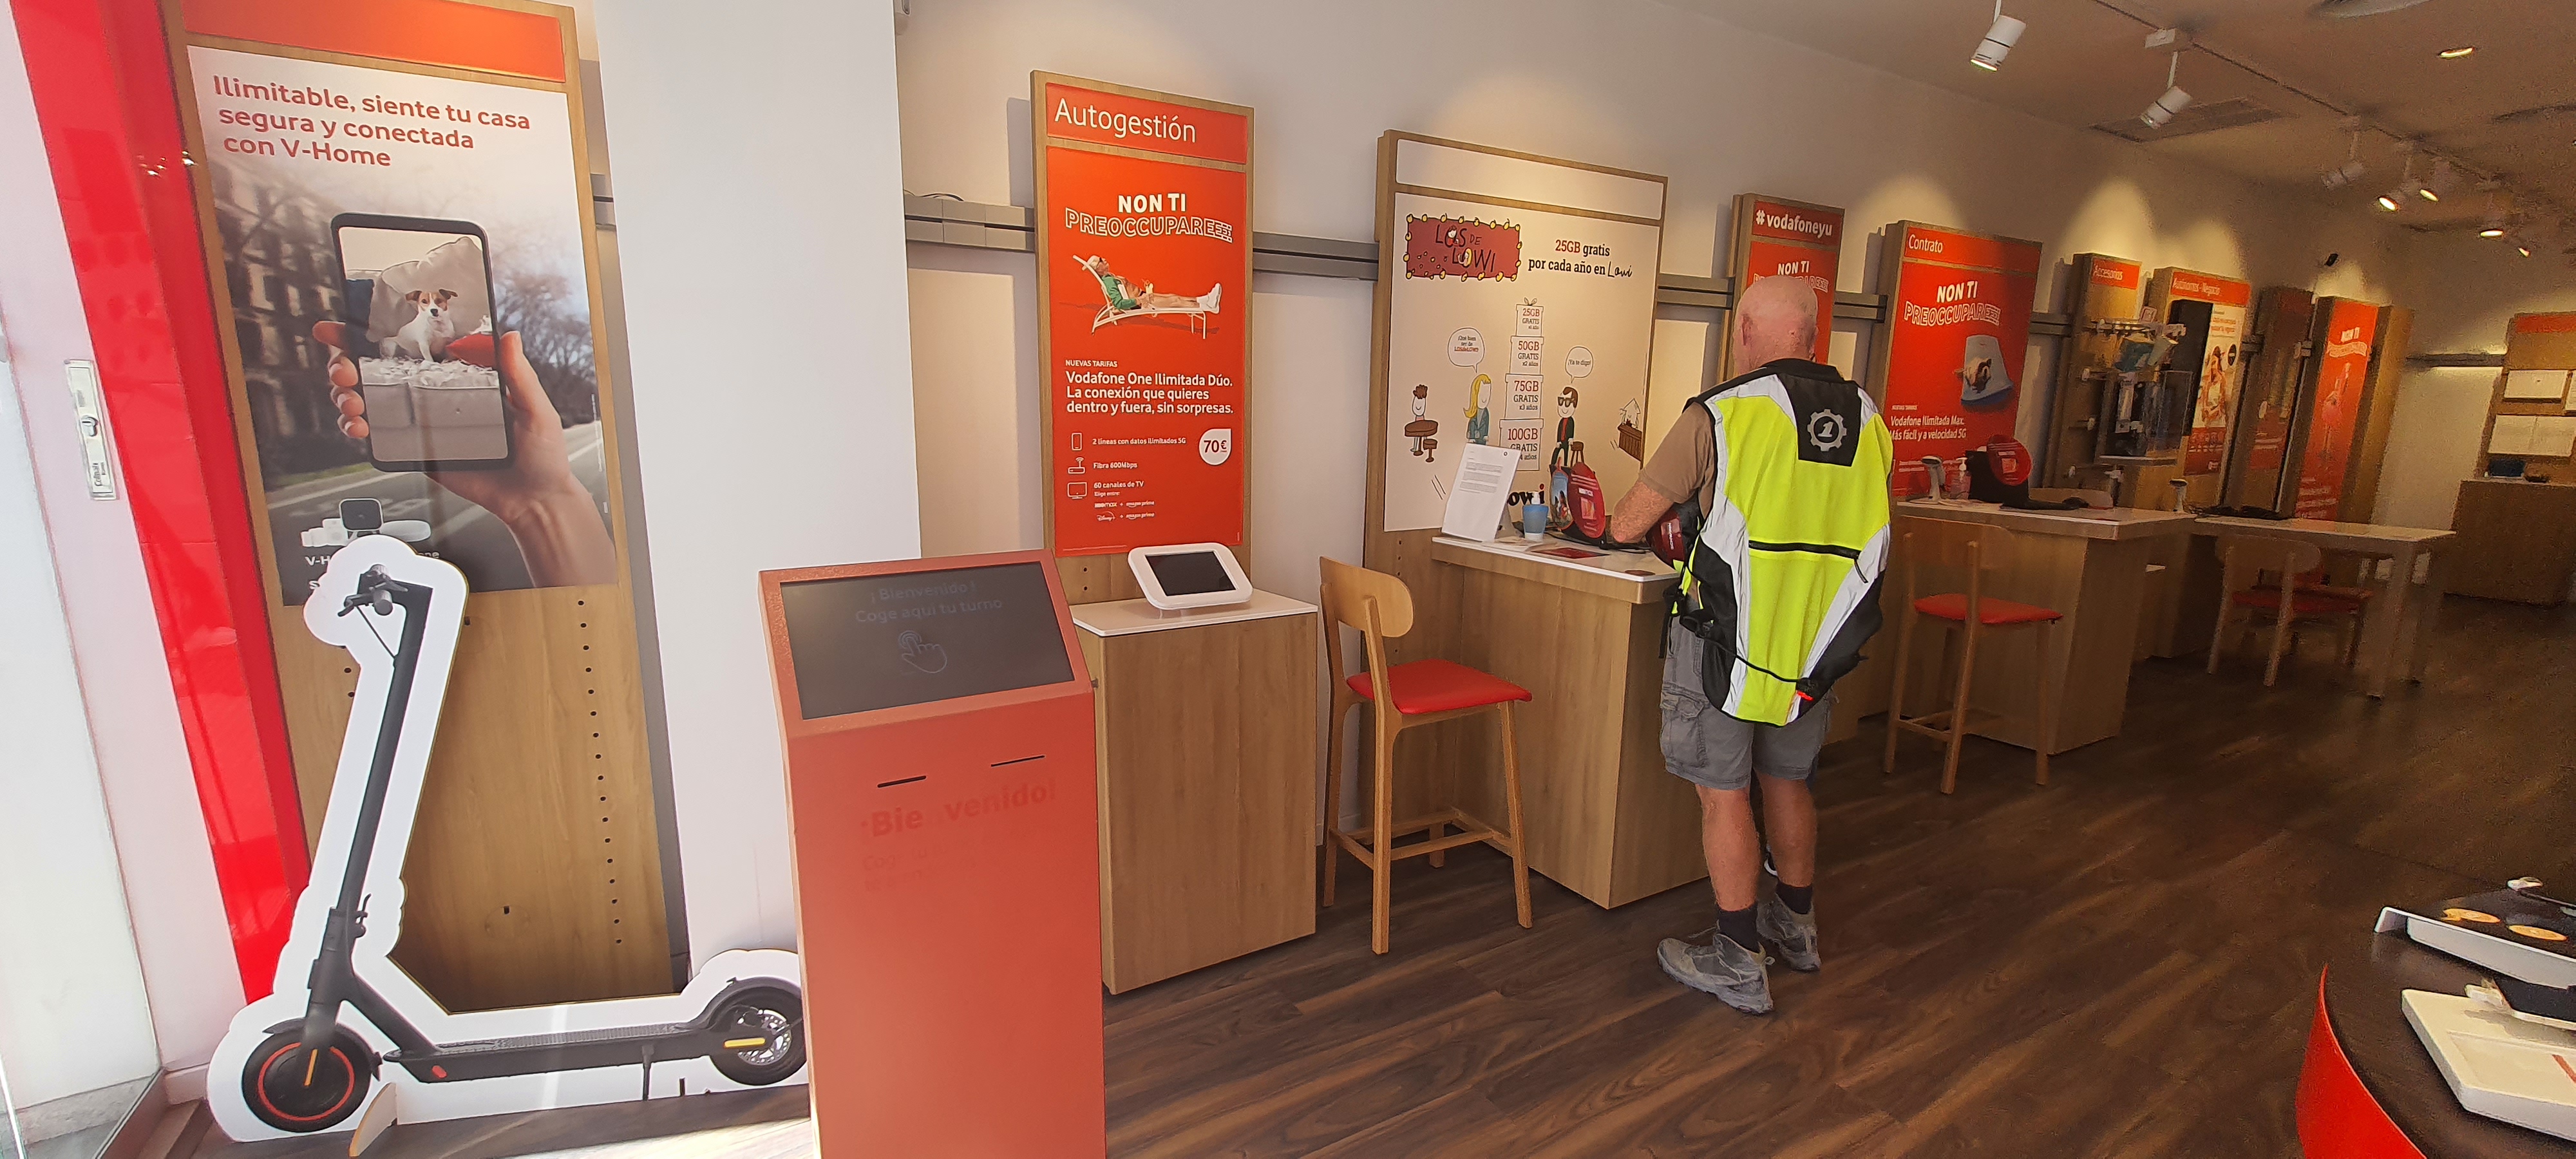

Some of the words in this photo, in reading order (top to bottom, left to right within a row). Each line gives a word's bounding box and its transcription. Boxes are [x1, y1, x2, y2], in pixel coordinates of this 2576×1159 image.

[213, 75, 356, 113] Ilimitable,
[362, 95, 440, 120] siente
[446, 104, 471, 124] tu
[478, 110, 531, 130] casa
[218, 107, 316, 133] segura
[321, 119, 337, 139] y
[343, 120, 474, 149] conectada
[1054, 97, 1197, 143] Autogestión
[223, 135, 275, 157] con
[281, 138, 392, 167] V-Home
[1118, 194, 1163, 214] NON
[1168, 193, 1186, 212] TI
[1756, 209, 1833, 239] #vodafoneyu
[1470, 234, 1482, 245] DE
[1908, 234, 1944, 254] Contrato
[1555, 239, 1581, 254] 25GB
[1582, 243, 1611, 259] gratis
[1528, 259, 1546, 272] por
[1548, 258, 1572, 273] cada
[1573, 261, 1593, 275] año
[1594, 264, 1605, 276] en
[1777, 261, 1799, 276] NON
[1801, 260, 1810, 273] TI
[1937, 283, 1965, 303] NON
[1967, 280, 1979, 299] TI
[1522, 308, 1540, 317] 25GB
[1518, 341, 1540, 351] 50GB
[1065, 359, 1092, 368] NUEVAS
[1517, 352, 1539, 361] GRATIS
[1066, 371, 1125, 385] Vodafone
[1128, 372, 1152, 385] One
[1155, 373, 1206, 386] Ilimitada
[1208, 374, 1233, 387] Dúo.
[1513, 381, 1539, 392] 75GB
[1066, 386, 1082, 399] La
[1084, 386, 1141, 399] conexión
[1142, 390, 1165, 402] que
[1167, 388, 1209, 402] quieres
[1513, 395, 1539, 403] GRATIS
[1066, 400, 1108, 413] dentro
[1110, 403, 1119, 415] y
[1120, 400, 1155, 415] fuera,
[1157, 401, 1174, 413] sin
[1177, 402, 1234, 416] sorpresas.
[1817, 421, 1834, 437] 1
[1891, 415, 1922, 427] Vodafone
[1922, 415, 1951, 426] Ilimitada
[1508, 428, 1538, 440] 100GB
[1902, 428, 1917, 440] fácil
[1917, 431, 1923, 442] y
[1923, 431, 1927, 440] a
[1927, 428, 1958, 440] velocidad
[1958, 428, 1967, 438] 5G
[1204, 440, 1227, 453] 70€
[1510, 443, 1538, 452] GRATIS
[1110, 461, 1138, 470] 600Mbps
[1508, 484, 1545, 506] owi
[878, 582, 969, 601] Bienvenido
[855, 609, 898, 624] Coge
[901, 603, 937, 619] aquí
[939, 603, 957, 614] tu
[960, 598, 1003, 612] turno
